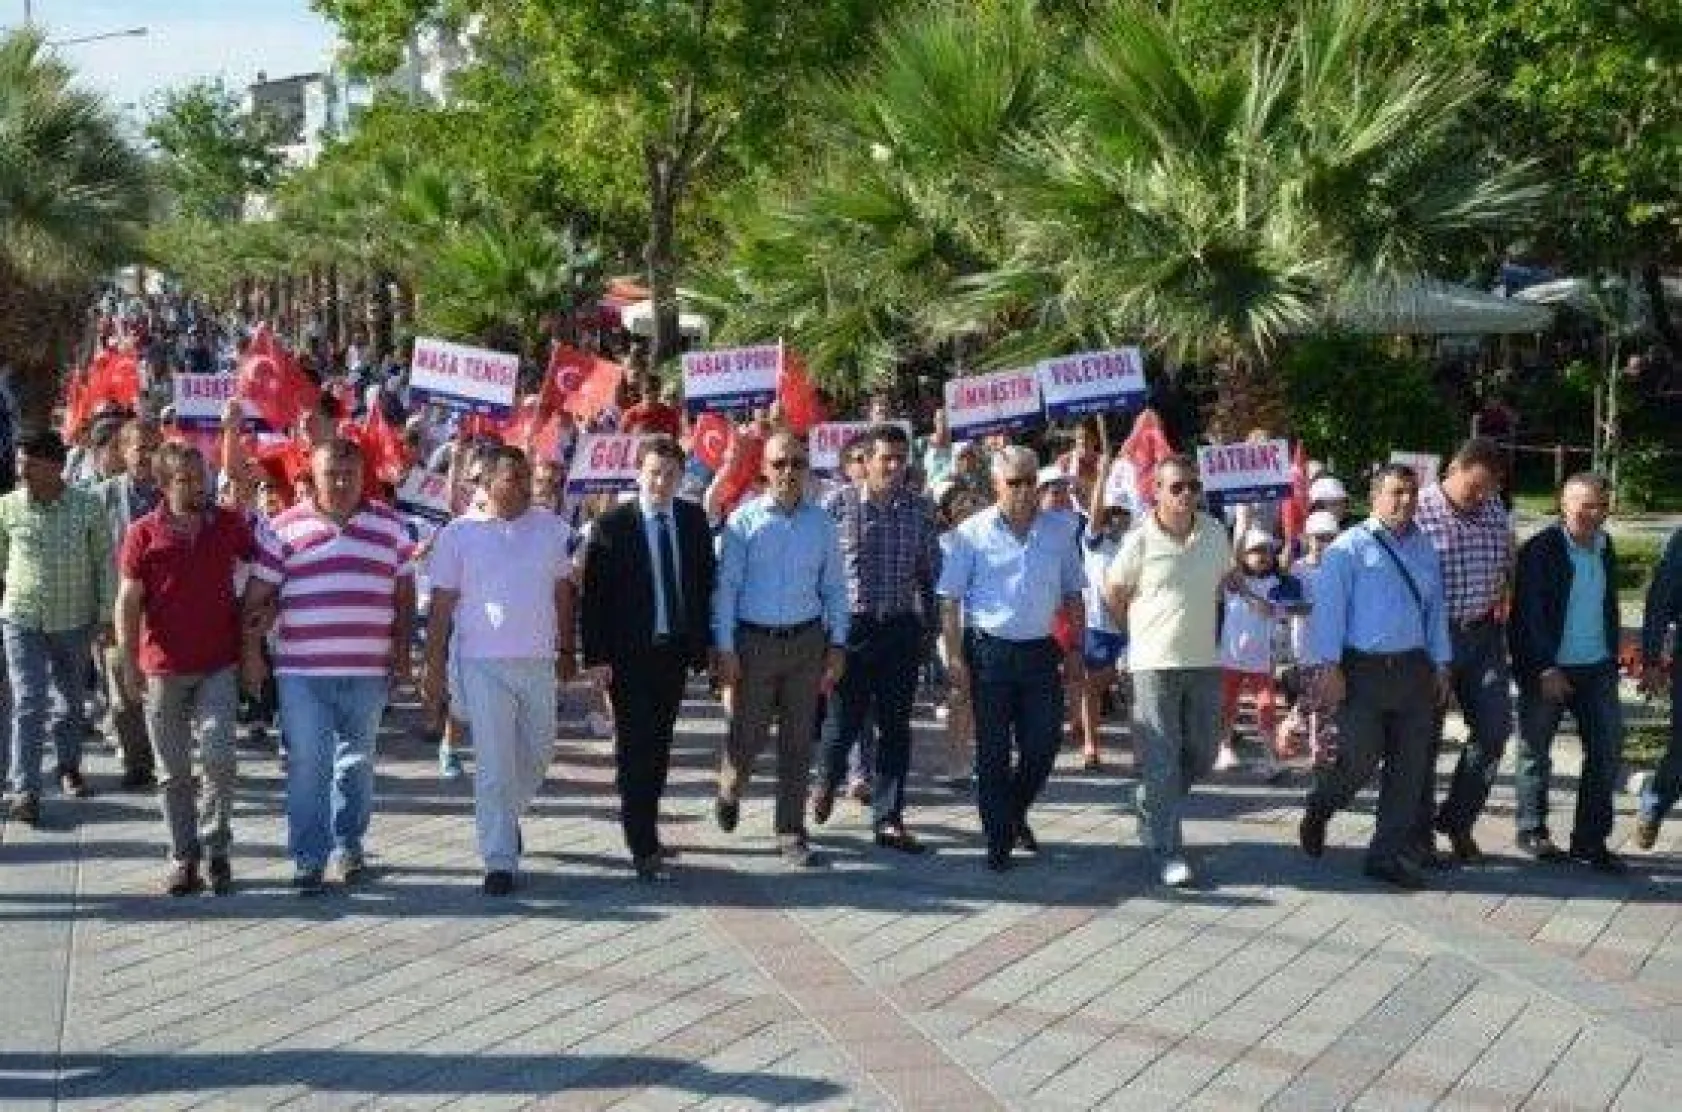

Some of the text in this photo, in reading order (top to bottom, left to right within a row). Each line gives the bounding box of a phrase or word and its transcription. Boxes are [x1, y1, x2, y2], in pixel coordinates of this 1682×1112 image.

[416, 347, 459, 376] MASA
[1049, 352, 1136, 386] VOLEYBOL
[181, 377, 237, 400] BASKE
[590, 438, 634, 471] GOL
